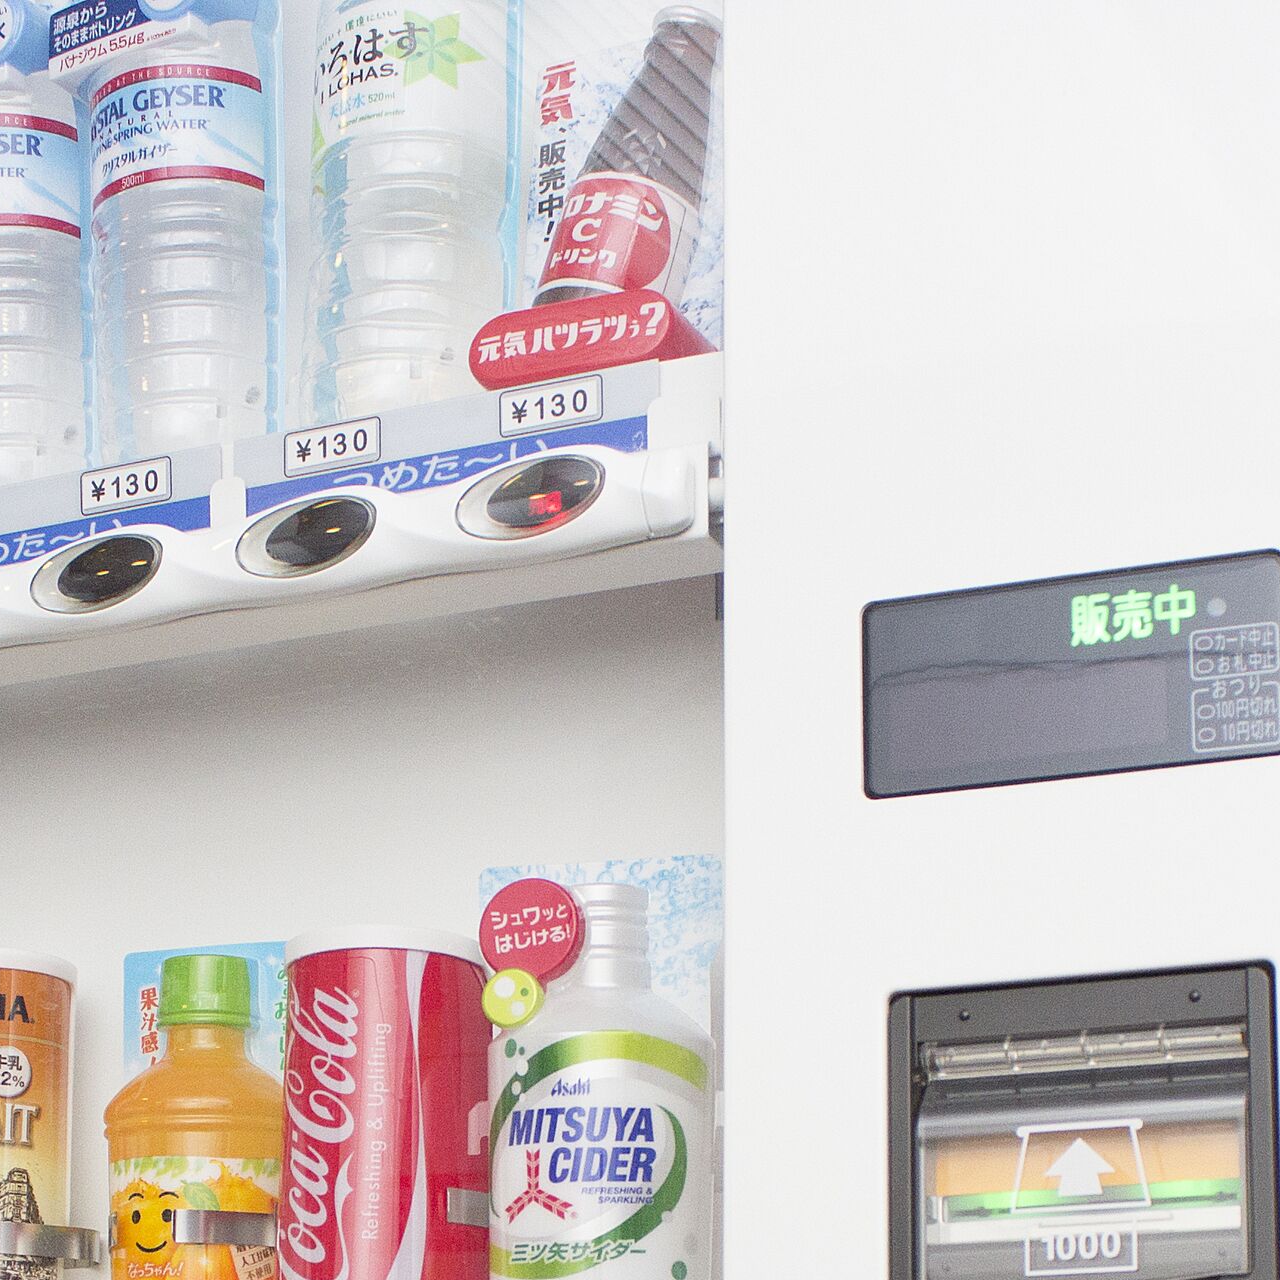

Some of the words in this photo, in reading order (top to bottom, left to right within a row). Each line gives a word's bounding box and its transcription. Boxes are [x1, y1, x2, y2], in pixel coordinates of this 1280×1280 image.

[53, 2, 108, 36] 源泉から
[59, 43, 107, 73] バナジウム
[159, 65, 210, 77] SOURCE
[133, 85, 225, 112] GEYSER
[100, 110, 173, 140] NATURAL
[113, 122, 153, 146] SPRING
[156, 118, 208, 131] WATER
[102, 142, 177, 177] クリスタルガイザー
[121, 172, 146, 189] 500ml
[572, 218, 602, 242] C
[549, 247, 618, 270] ドリンク
[511, 389, 588, 424] ¥130
[296, 428, 368, 463] ¥130
[90, 469, 158, 502] ¥130
[1070, 583, 1197, 647] 販売中
[1219, 650, 1274, 674] お札中止
[1212, 675, 1261, 699] おつり
[490, 902, 569, 930] シュワッと
[371, 1022, 393, 1108] Uplifting
[550, 1077, 592, 1098] Asahi
[508, 1104, 656, 1148] MITSUYA
[547, 1146, 658, 1185] CIDER
[361, 1138, 383, 1241] Refreshing
[580, 1185, 644, 1196] REFRESHING
[597, 1195, 654, 1206] SPARKLING
[511, 1239, 647, 1264] 三ツ矢サイダー
[1041, 1231, 1121, 1261] 1000
[127, 1262, 184, 1279] なっちゃん!
